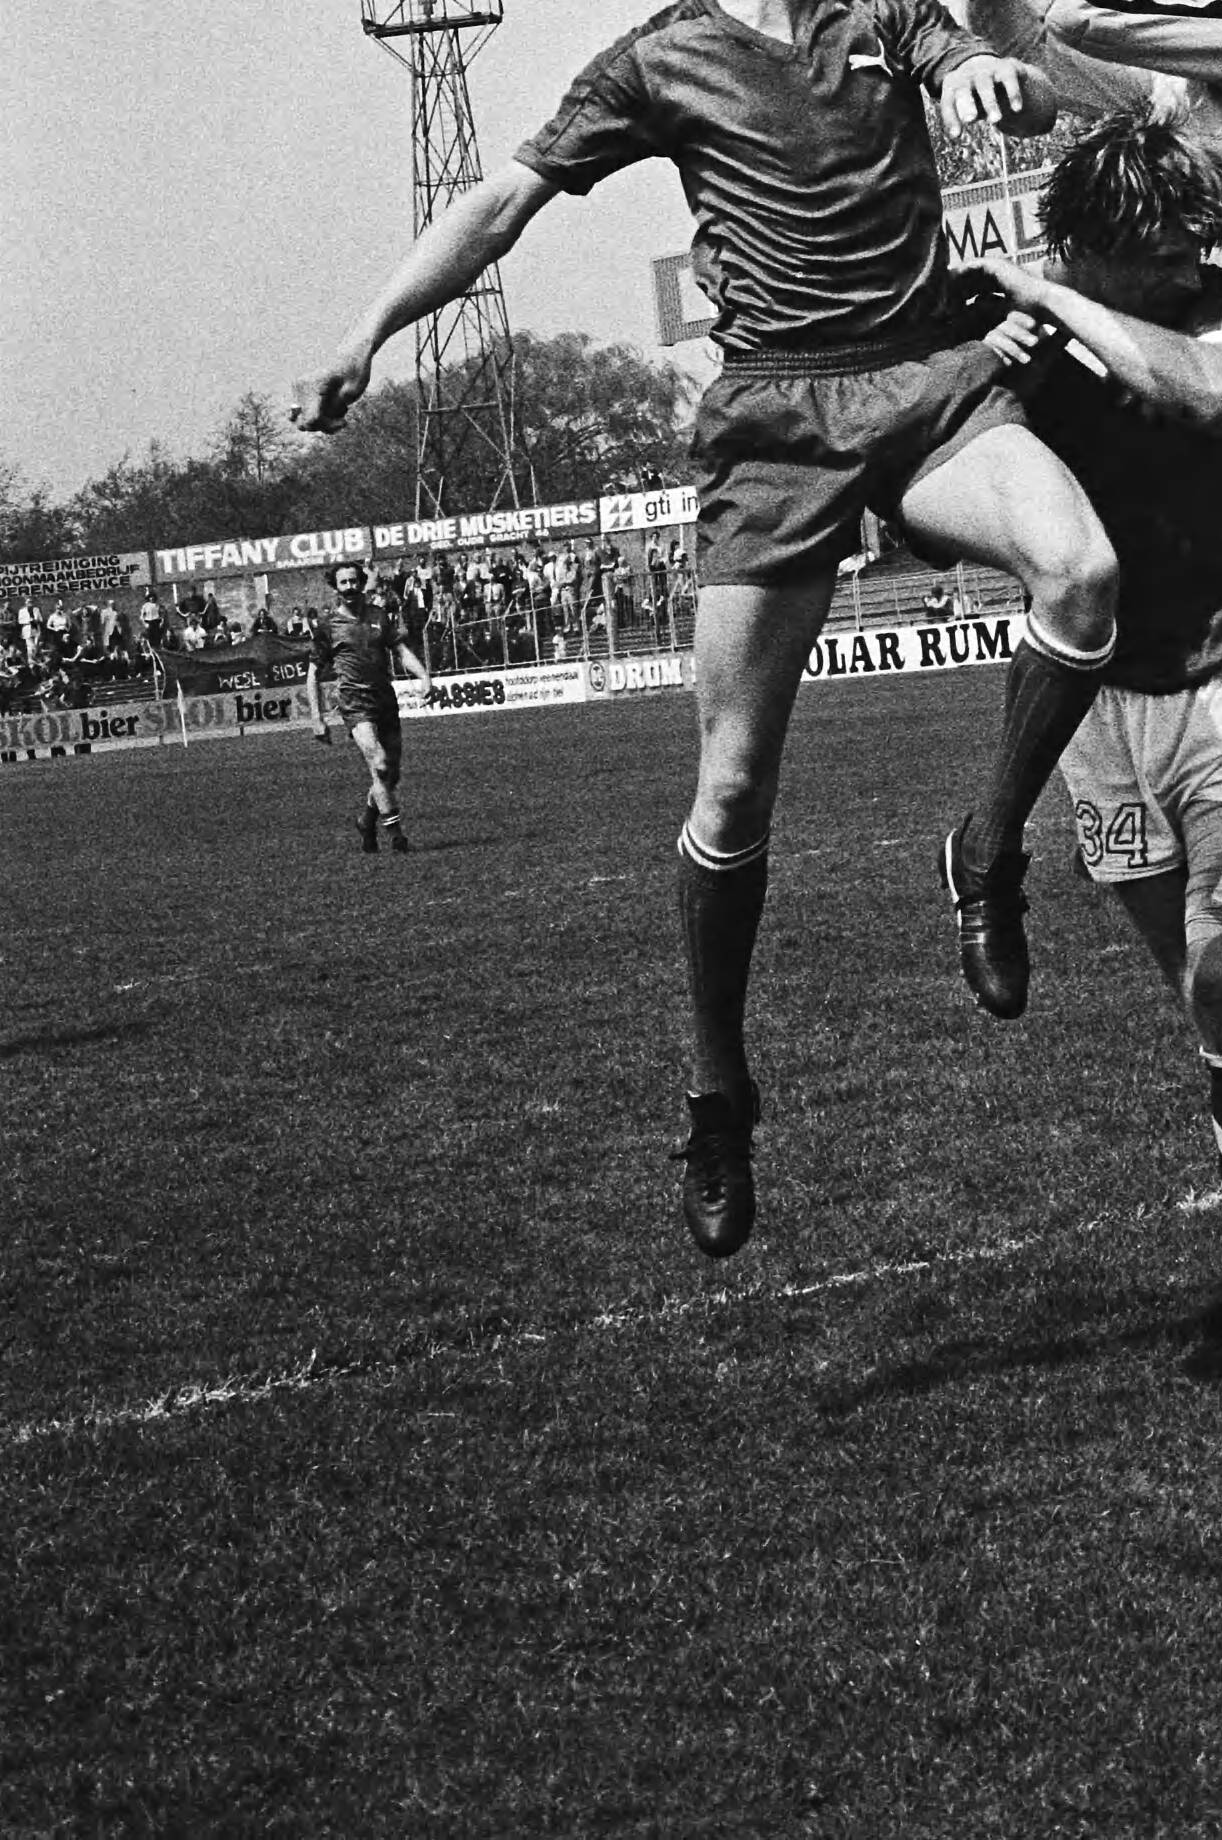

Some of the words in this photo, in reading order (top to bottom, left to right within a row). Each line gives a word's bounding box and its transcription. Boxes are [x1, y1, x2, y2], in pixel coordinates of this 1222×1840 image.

[374, 525, 404, 548] DE
[407, 518, 456, 544] DRIE
[460, 502, 597, 537] MUSKETIERS
[645, 494, 671, 522] gti
[157, 537, 279, 573] TIFFANY
[290, 526, 365, 558] CLUB
[57, 575, 130, 593] SERVICE
[916, 619, 1013, 667] RUM
[272, 662, 307, 682] SIDE
[606, 658, 683, 692] DRUM
[80, 709, 140, 741] bier
[234, 692, 292, 723] bier
[1075, 799, 1149, 869] 34
